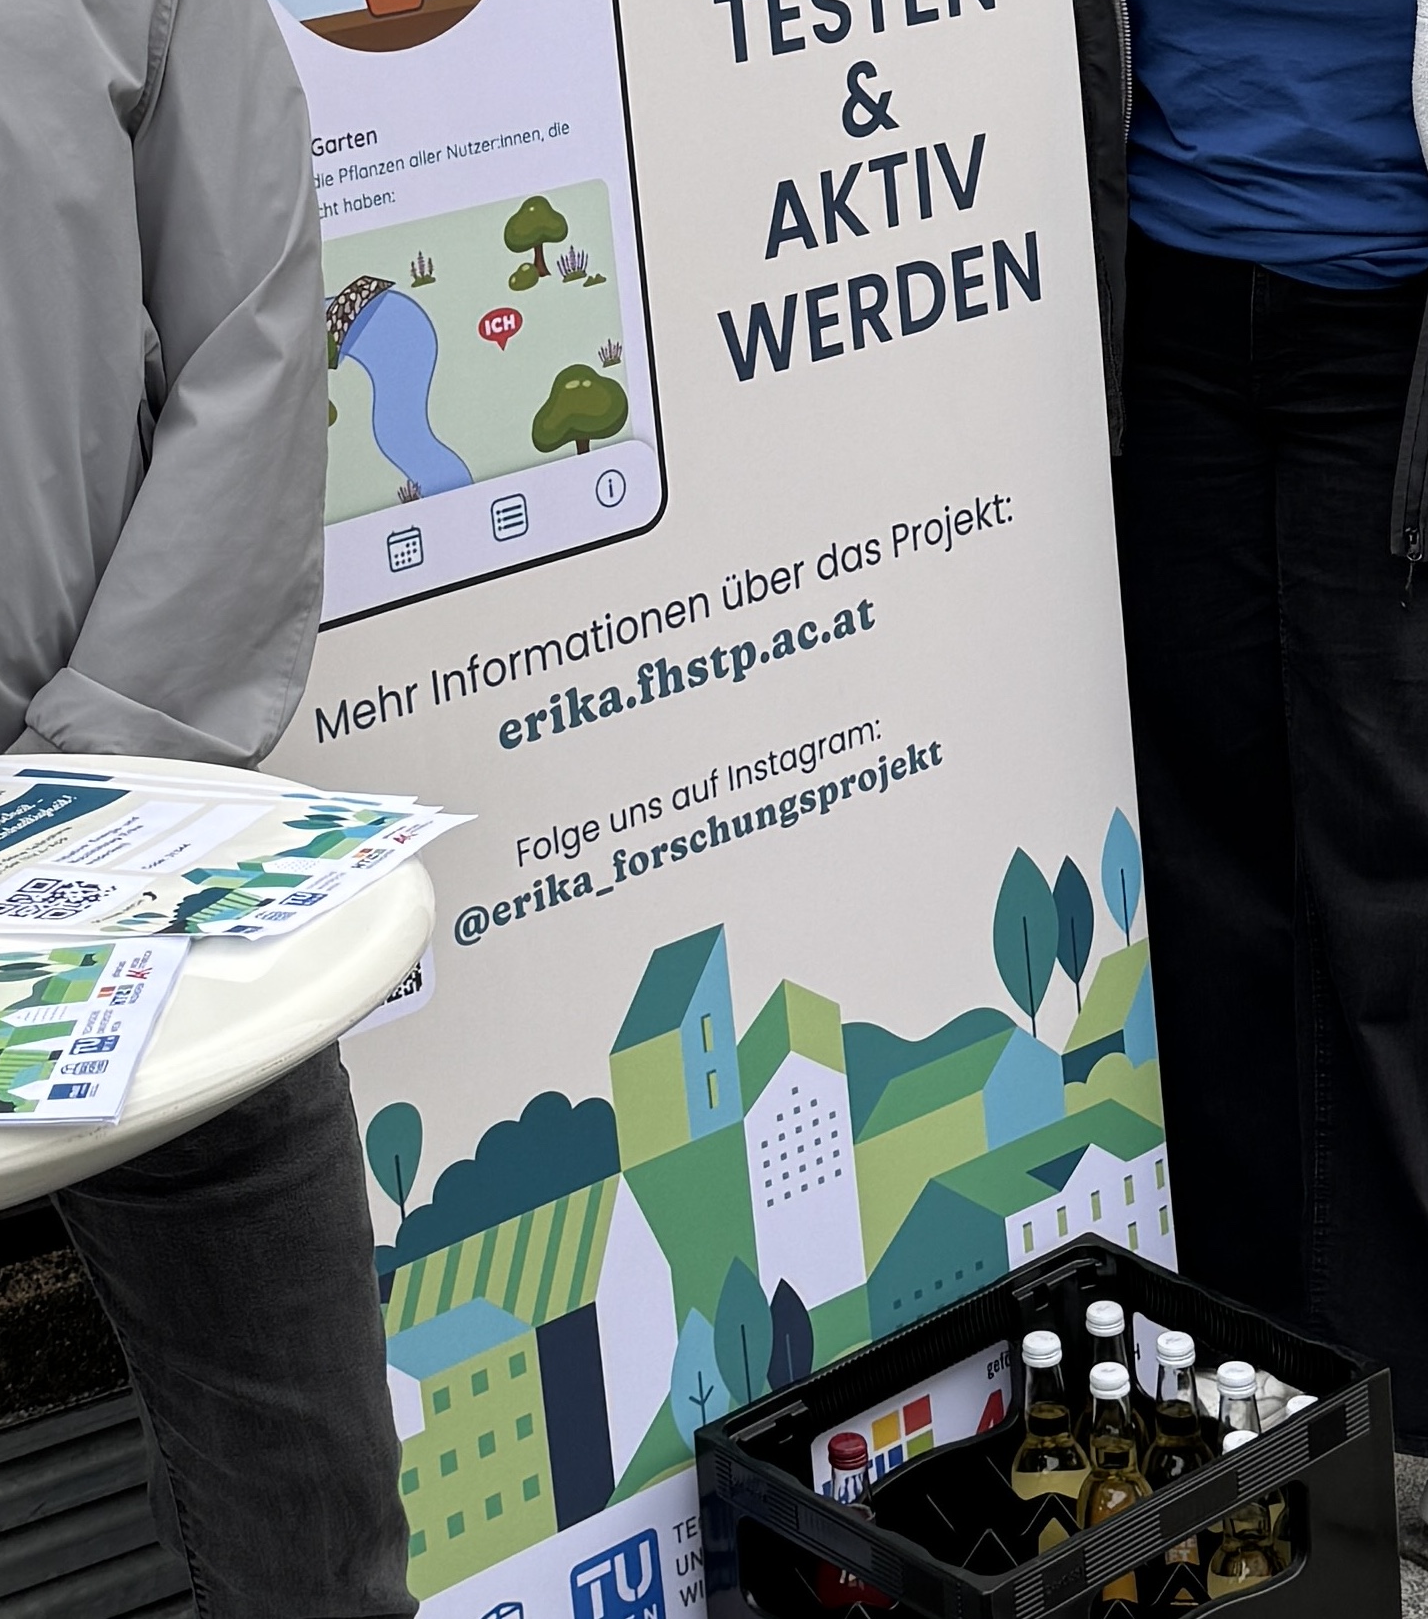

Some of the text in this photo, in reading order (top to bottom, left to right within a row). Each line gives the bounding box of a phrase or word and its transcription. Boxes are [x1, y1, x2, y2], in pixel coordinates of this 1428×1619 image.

[842, 60, 899, 137] &
[311, 130, 378, 156] Garten
[339, 157, 404, 183] Pflanzen
[409, 148, 442, 168] aller
[548, 121, 570, 138] die
[344, 190, 395, 213] haben:
[764, 133, 986, 260] AKTIV
[484, 313, 516, 334] ICH
[718, 231, 1041, 382] WERDEN
[316, 495, 1015, 742] Mehr Informationen über das Projekt:
[498, 595, 877, 750] erika.fhstp.ac.at
[515, 720, 882, 867] Folge uns auf Instagram:
[453, 739, 944, 946] @erika_forschungsprojekt
[673, 1516, 700, 1543] TE
[577, 1540, 652, 1619] TU
